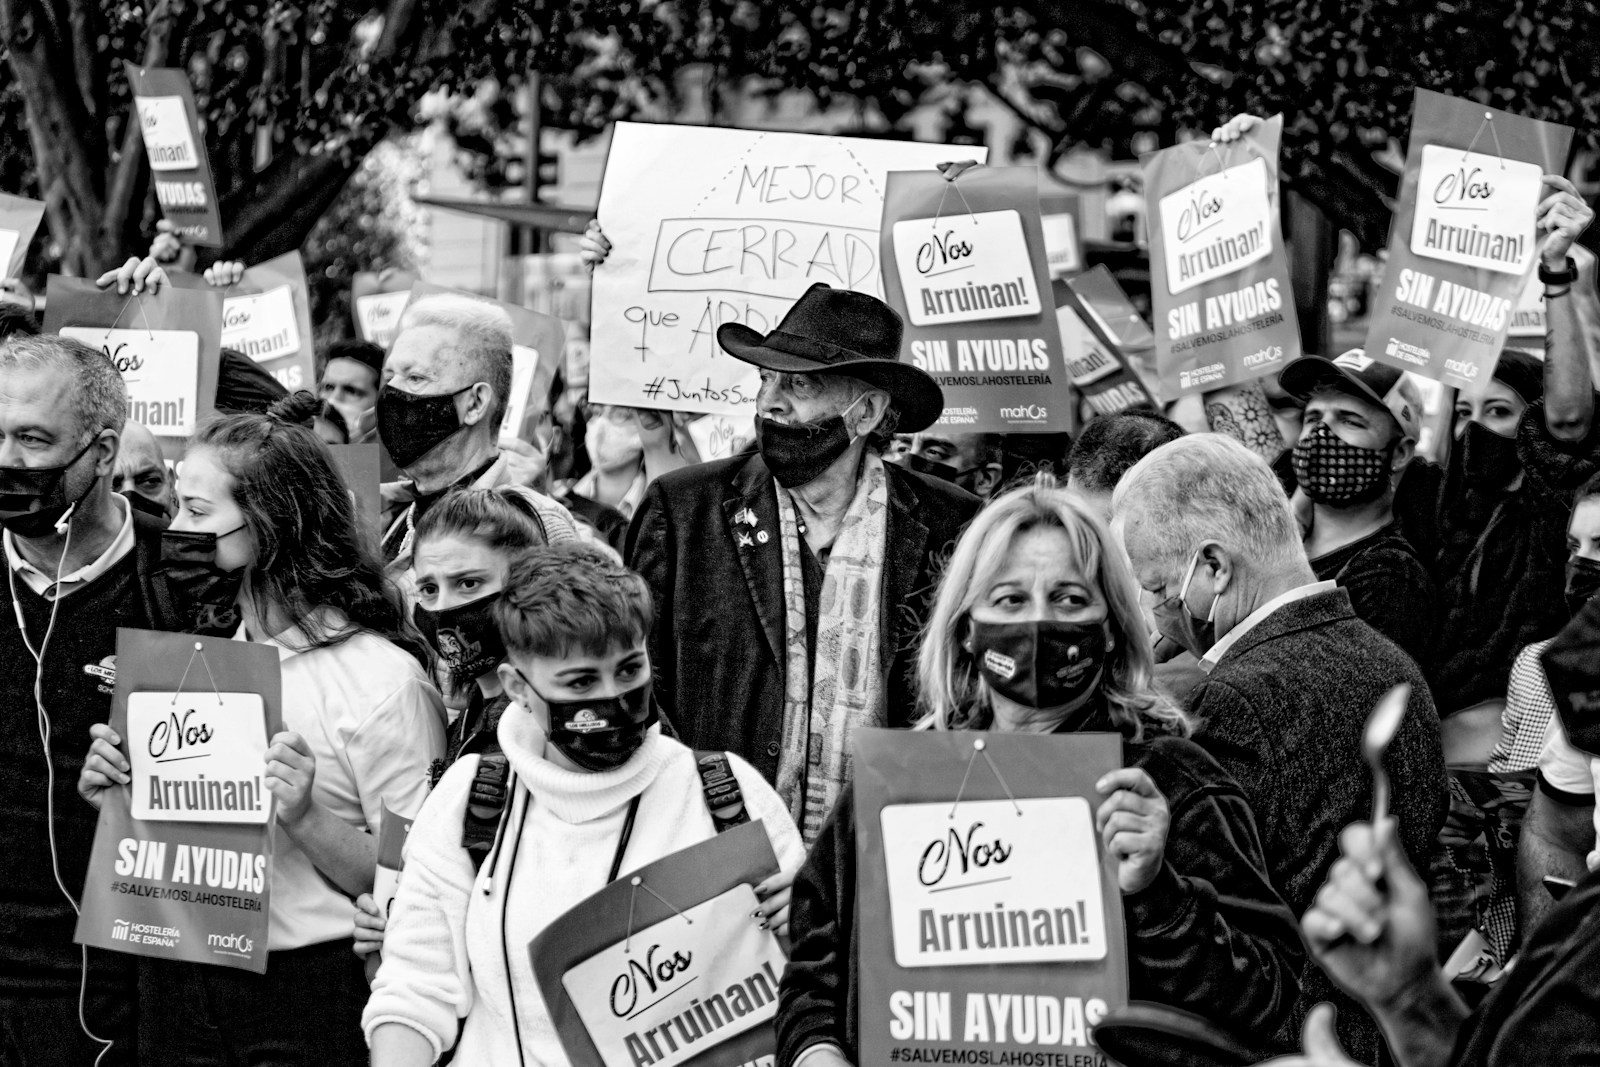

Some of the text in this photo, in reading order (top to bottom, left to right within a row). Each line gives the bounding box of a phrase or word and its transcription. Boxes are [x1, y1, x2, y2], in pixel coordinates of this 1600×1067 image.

[154, 181, 208, 206] YUDAS
[735, 164, 863, 205] MEJOR
[1433, 167, 1495, 204] Nos
[1177, 189, 1223, 241] Nos
[916, 230, 973, 274] Nos
[1178, 220, 1265, 282] Arruinan!
[1424, 217, 1525, 265] Arruinan!
[920, 277, 1029, 316] Arruinan!
[1168, 278, 1282, 340] SIN AYUDAS
[1395, 268, 1512, 332] SIN AYUDAS
[623, 306, 680, 363] que
[910, 338, 1050, 372] SIN AYUDAS
[148, 708, 214, 758] Nos
[149, 774, 262, 811] Arruinan!
[114, 837, 266, 894] SIN AYUDAS
[917, 821, 1012, 887] Nos
[110, 881, 262, 913] #SALVEMOSLAHOSTELERÍA
[129, 933, 174, 948] DE ESPAÑA
[131, 923, 181, 938] HOSTELERÍA
[919, 900, 1089, 953] Arruinan!
[609, 944, 692, 1018] Nos
[623, 960, 780, 1067] Arruinan!
[889, 990, 1109, 1048] SIN AYUDAS
